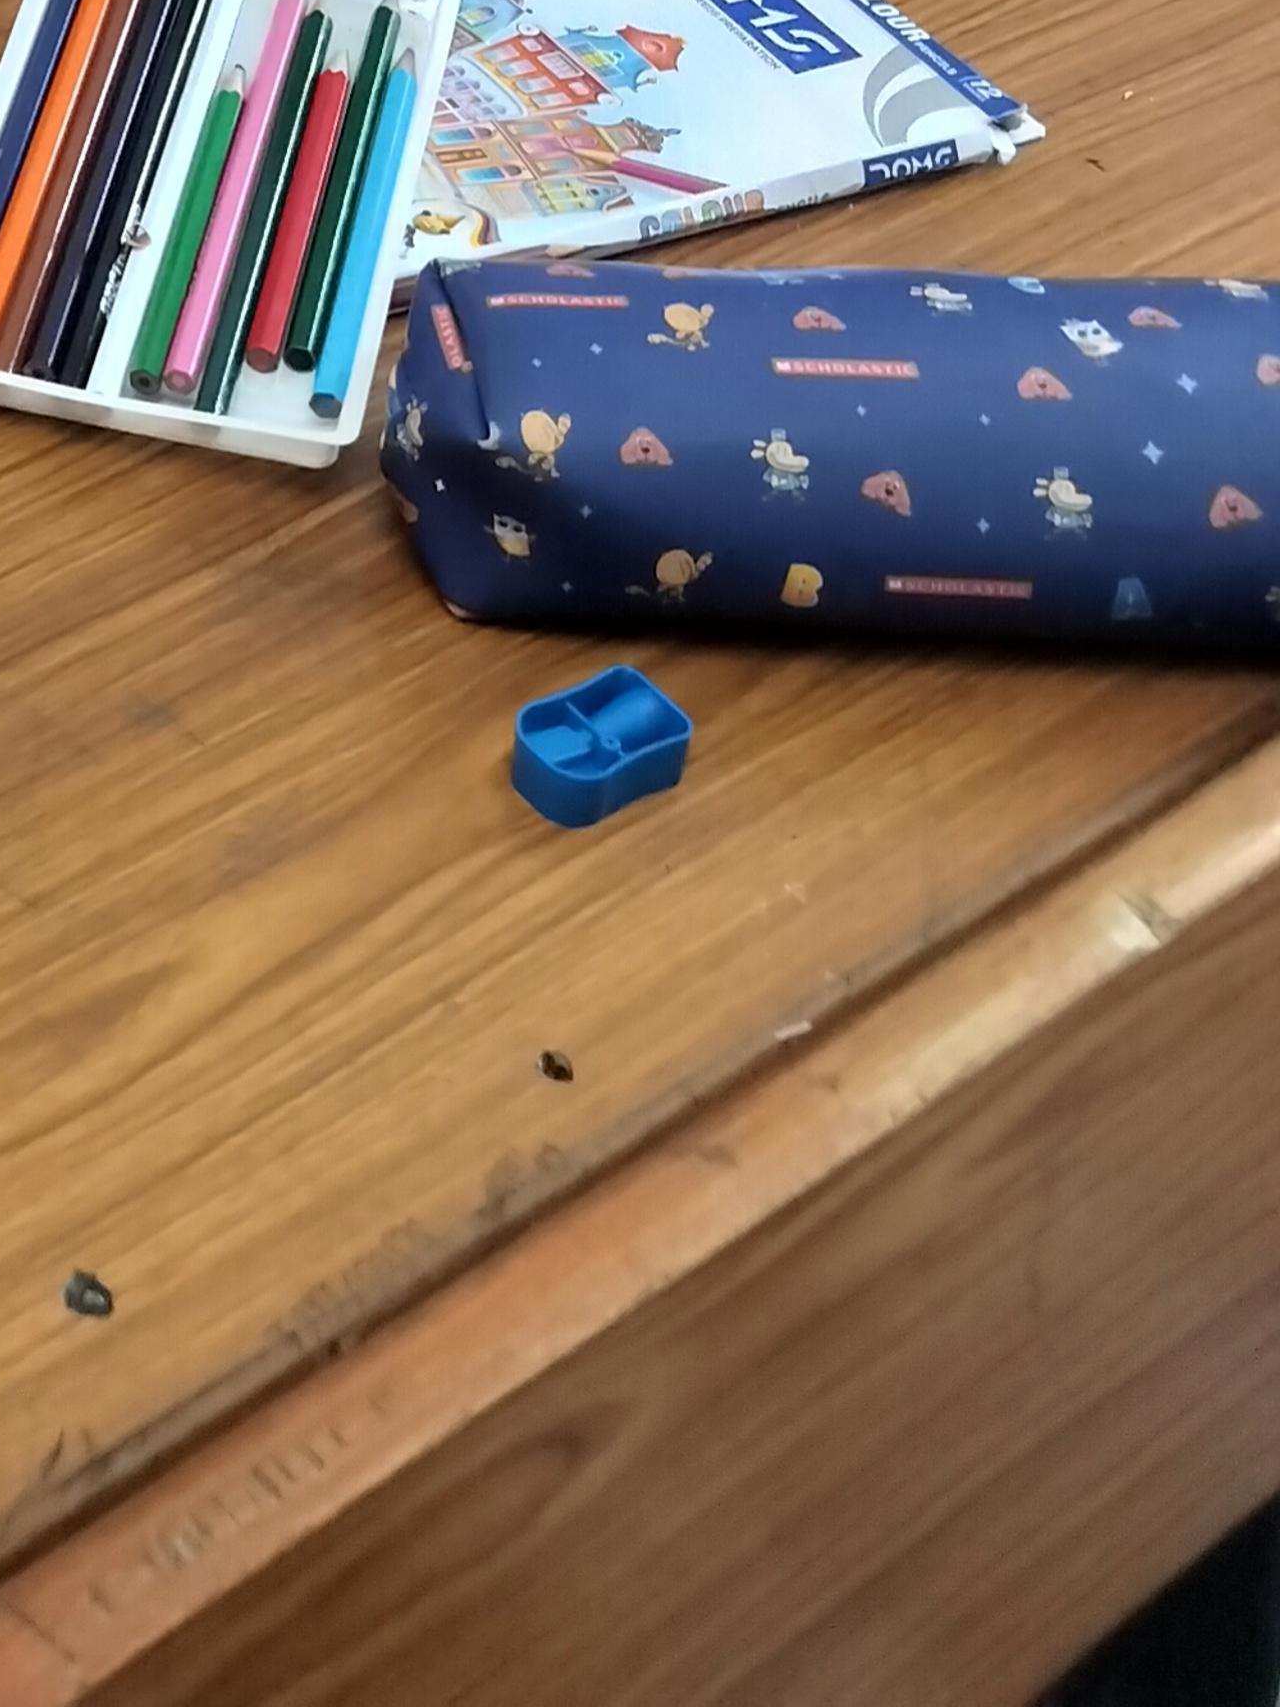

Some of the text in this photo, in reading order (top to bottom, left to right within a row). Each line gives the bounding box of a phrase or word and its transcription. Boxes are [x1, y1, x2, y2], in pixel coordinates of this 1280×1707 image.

[507, 296, 625, 306] SCHOLASTIC
[794, 359, 917, 377] SCHOLASTIC
[904, 577, 1031, 598] SCHOLASTIC
